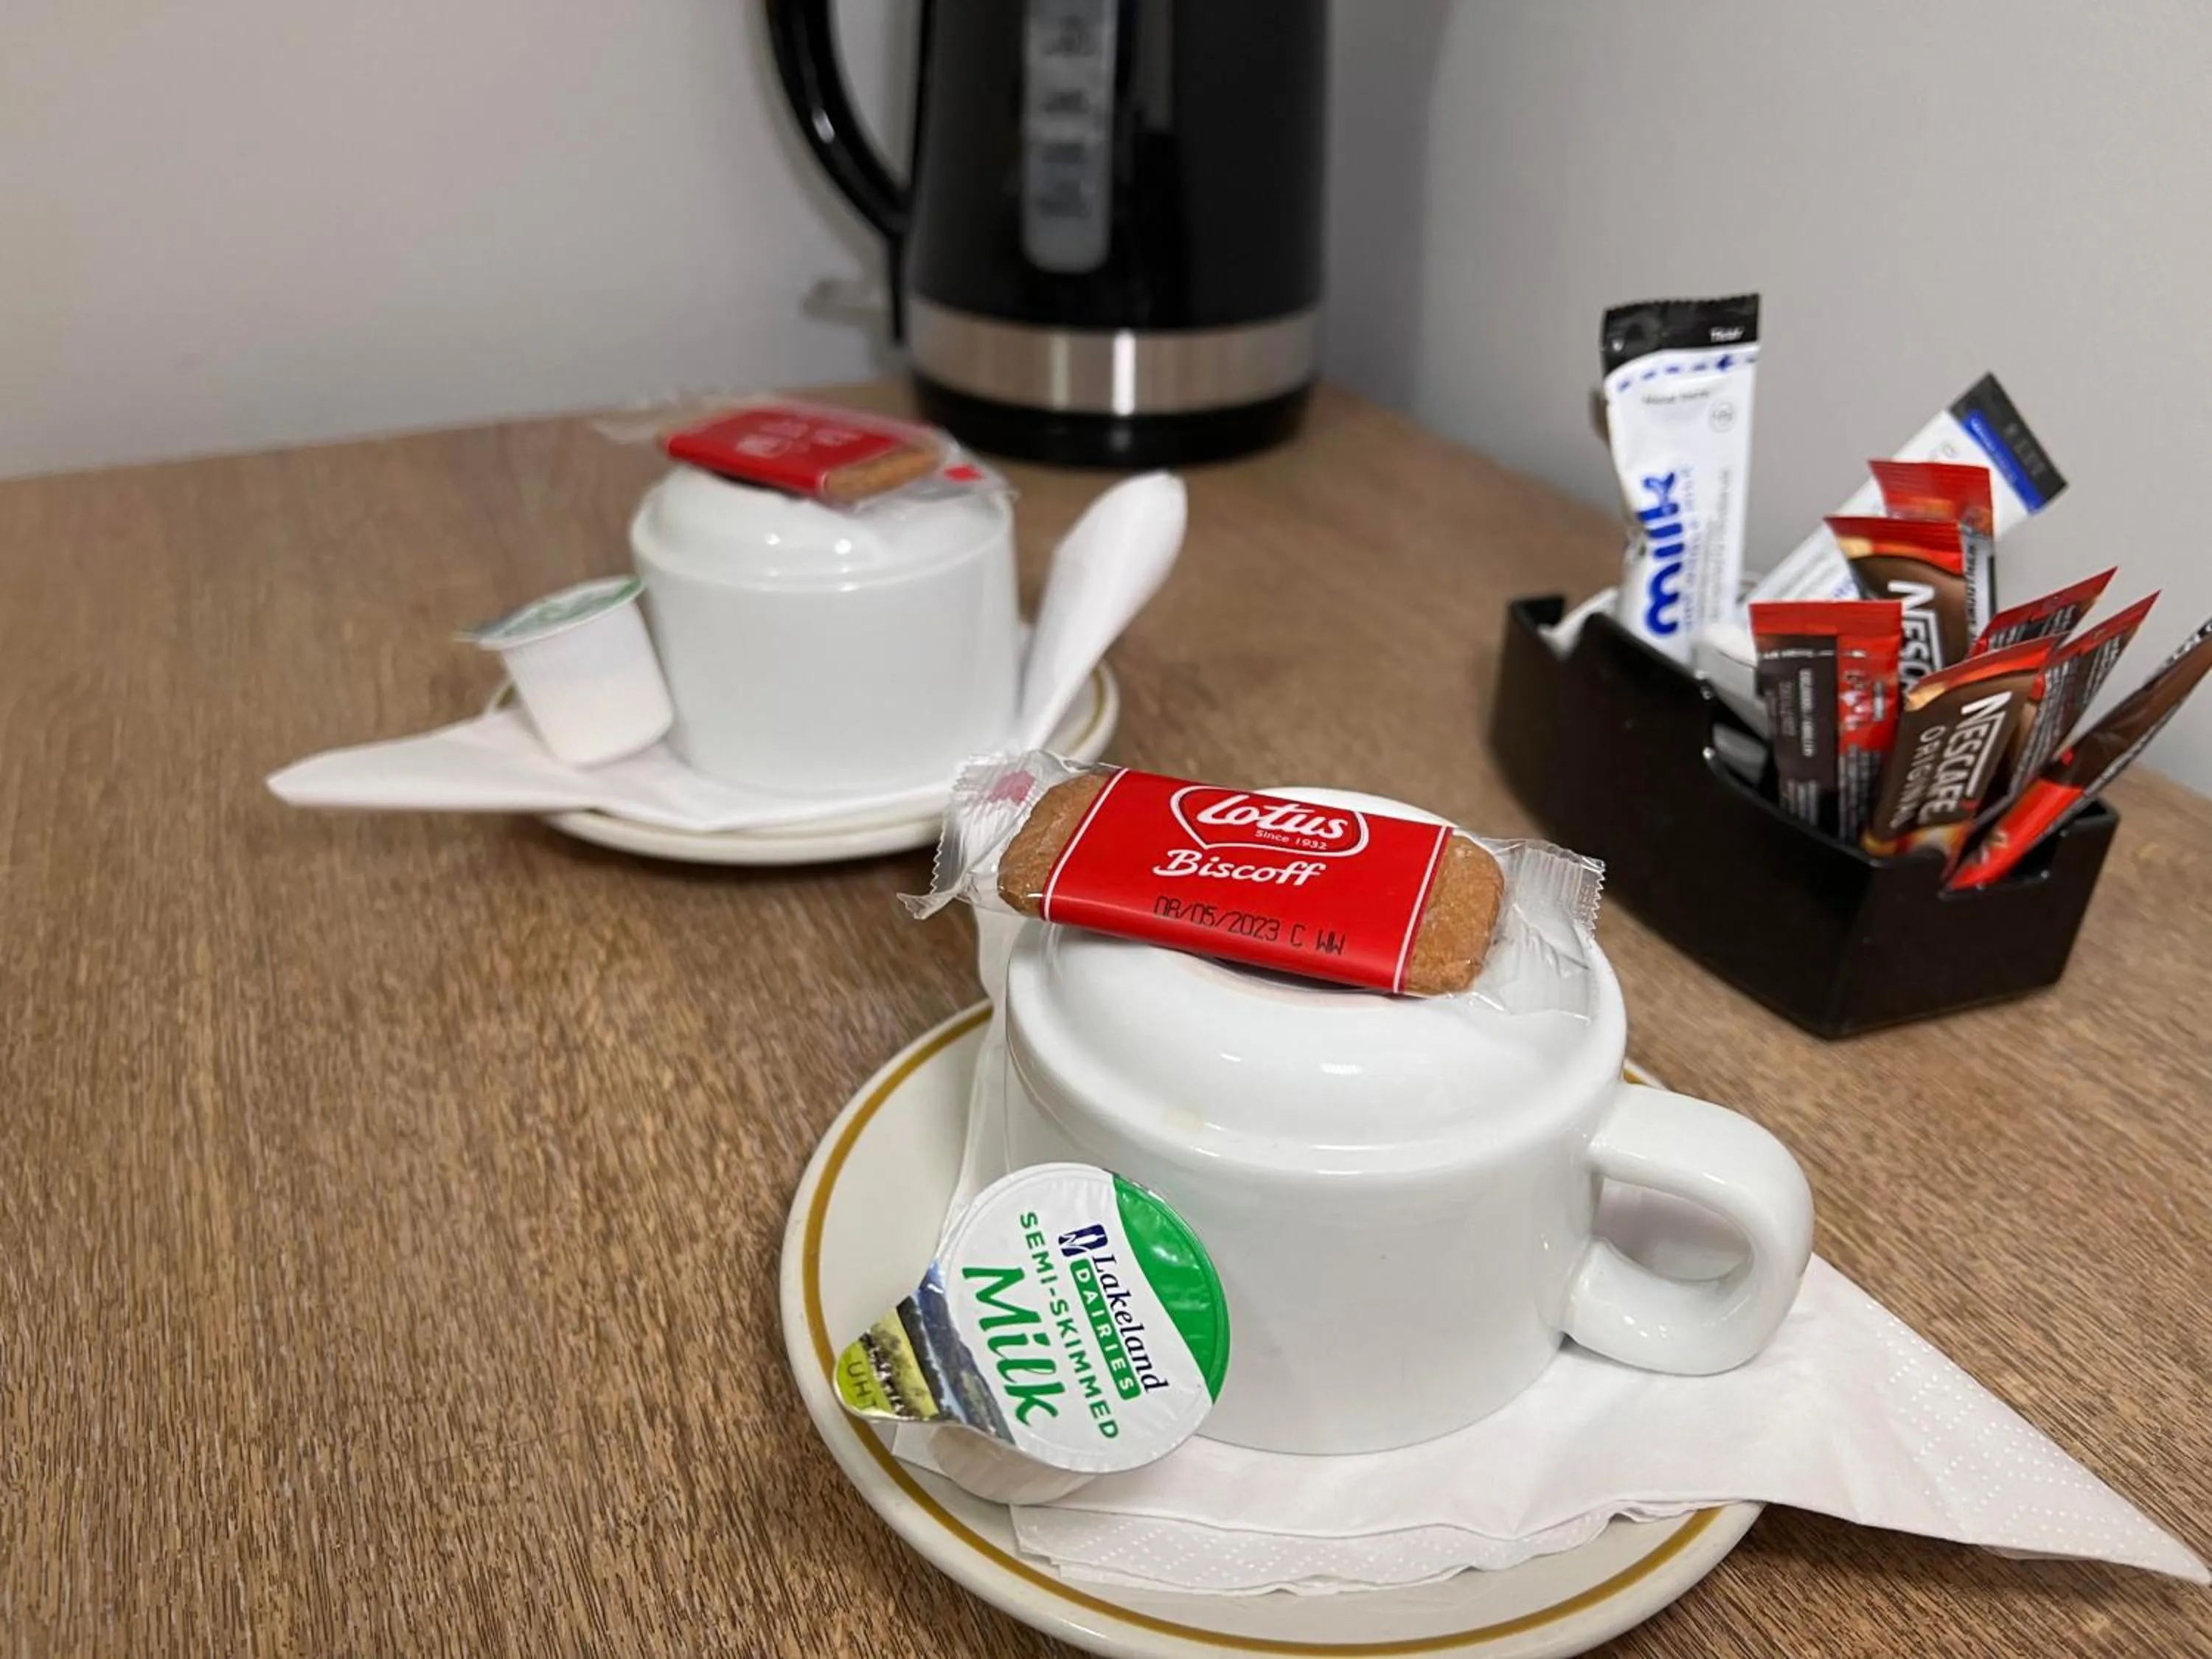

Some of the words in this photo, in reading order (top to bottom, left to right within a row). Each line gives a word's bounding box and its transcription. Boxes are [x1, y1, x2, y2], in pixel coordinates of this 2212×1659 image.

[1636, 472, 1684, 636] milk
[1152, 849, 1326, 886] Biscoff
[1196, 793, 1349, 839] Lotus
[1255, 830, 1290, 843] Since
[1295, 838, 1328, 850] 1932
[1154, 895, 1281, 942] 08/05/2023
[1290, 923, 1307, 948] C
[961, 1267, 1065, 1427] Milk
[1020, 1211, 1119, 1439] SEMI-SKIMMED
[1075, 1267, 1134, 1391] DAIRIES
[1092, 1253, 1169, 1392] Lakeland
